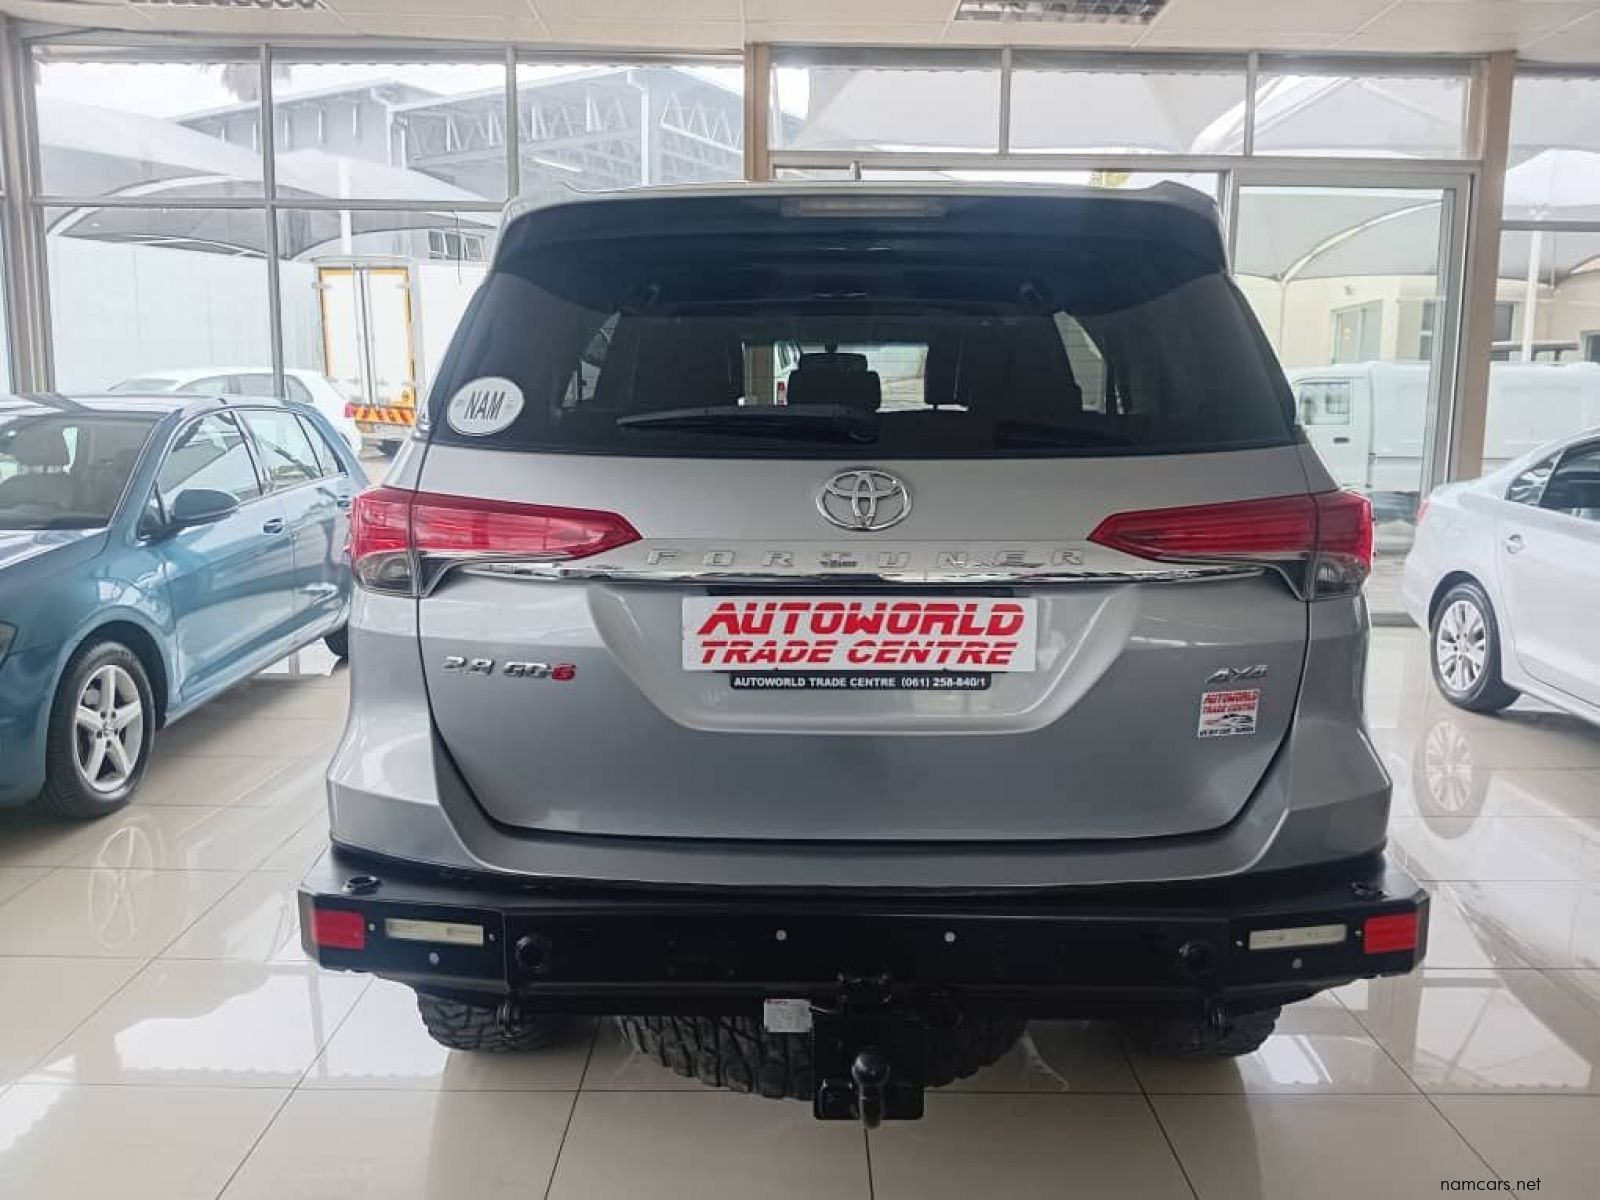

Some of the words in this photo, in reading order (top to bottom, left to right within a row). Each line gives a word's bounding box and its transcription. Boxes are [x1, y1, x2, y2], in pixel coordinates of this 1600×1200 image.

[463, 391, 506, 420] NAM
[647, 548, 1084, 569] FORTUNER
[697, 602, 1025, 636] AUTOWORLD
[702, 640, 838, 664] TRADE
[847, 640, 1018, 665] CENTRE
[734, 676, 806, 688] AUTOWORLD
[809, 676, 847, 688] TRADE
[850, 676, 896, 688] CENTRE
[901, 676, 930, 689] (061)
